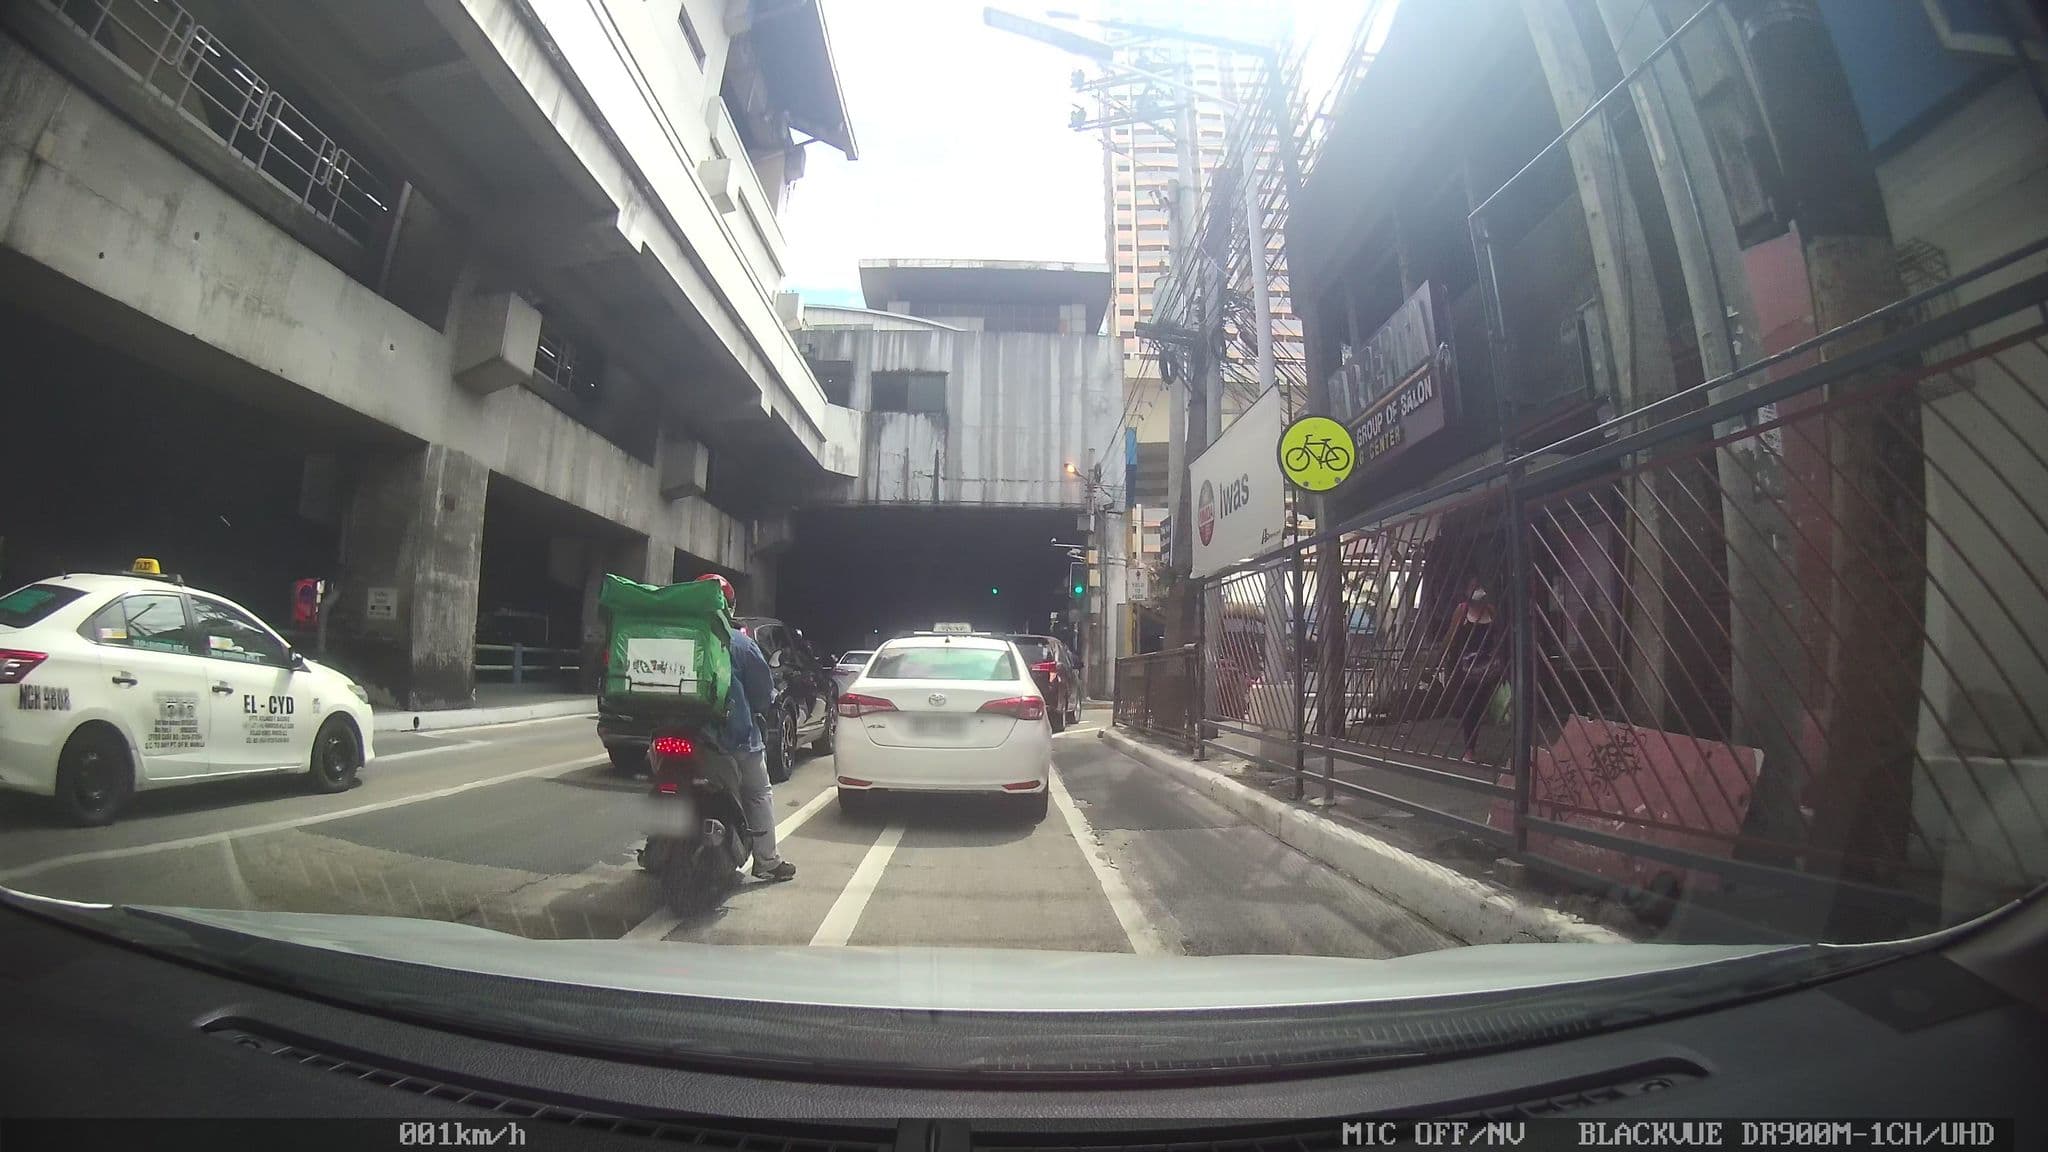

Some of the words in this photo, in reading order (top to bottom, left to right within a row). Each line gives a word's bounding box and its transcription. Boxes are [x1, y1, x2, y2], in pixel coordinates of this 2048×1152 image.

[1357, 414, 1384, 448] GROUP
[1386, 401, 1397, 425] OF
[1400, 376, 1433, 416] SALON
[1369, 426, 1401, 460] CENTER
[1219, 473, 1250, 520] Iwas
[243, 694, 257, 714] EL
[269, 695, 294, 715] CYD
